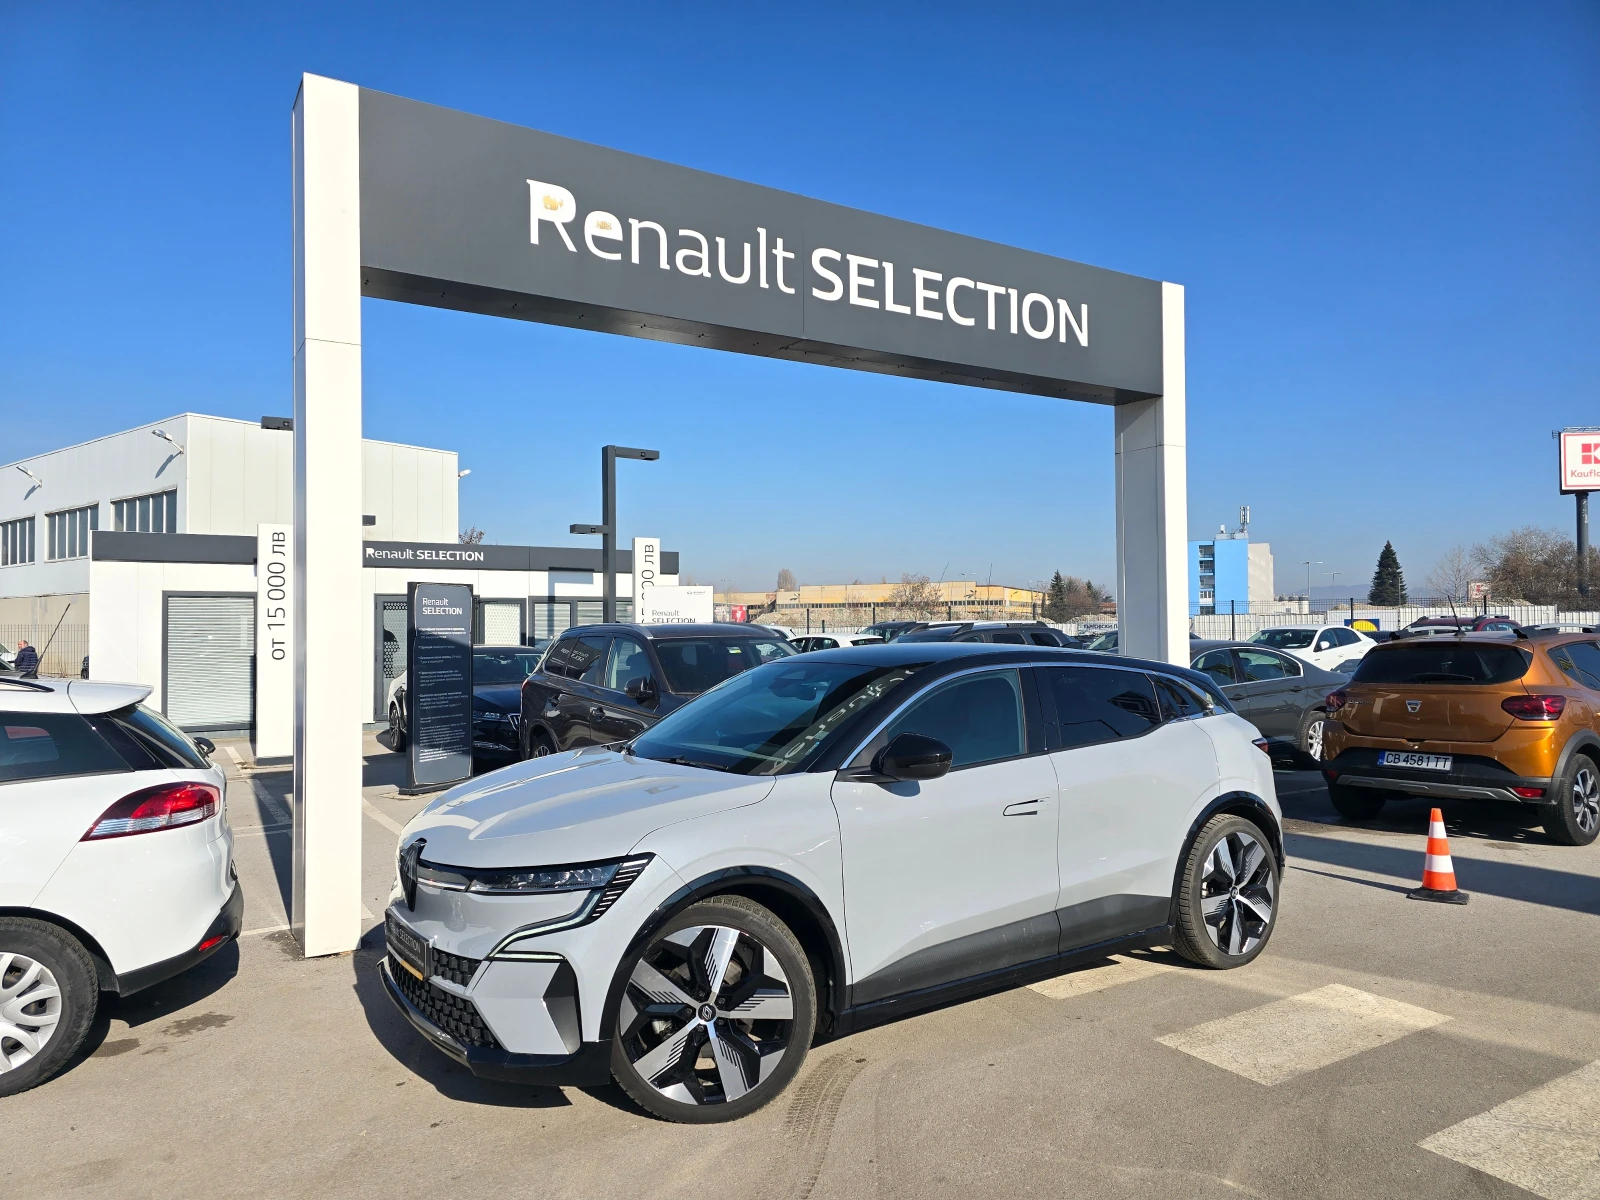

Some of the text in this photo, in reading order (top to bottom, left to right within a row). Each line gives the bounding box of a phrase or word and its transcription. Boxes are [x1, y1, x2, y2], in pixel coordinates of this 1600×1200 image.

[526, 178, 1089, 347] Renault SELECTION
[365, 547, 484, 562] Renault SELECTION
[267, 562, 286, 601] 000
[422, 597, 449, 606] Renault
[267, 607, 286, 631] 15
[422, 607, 463, 615] SELECTION
[651, 609, 680, 617] Renault
[1385, 752, 1450, 769] CB 4581 TT
